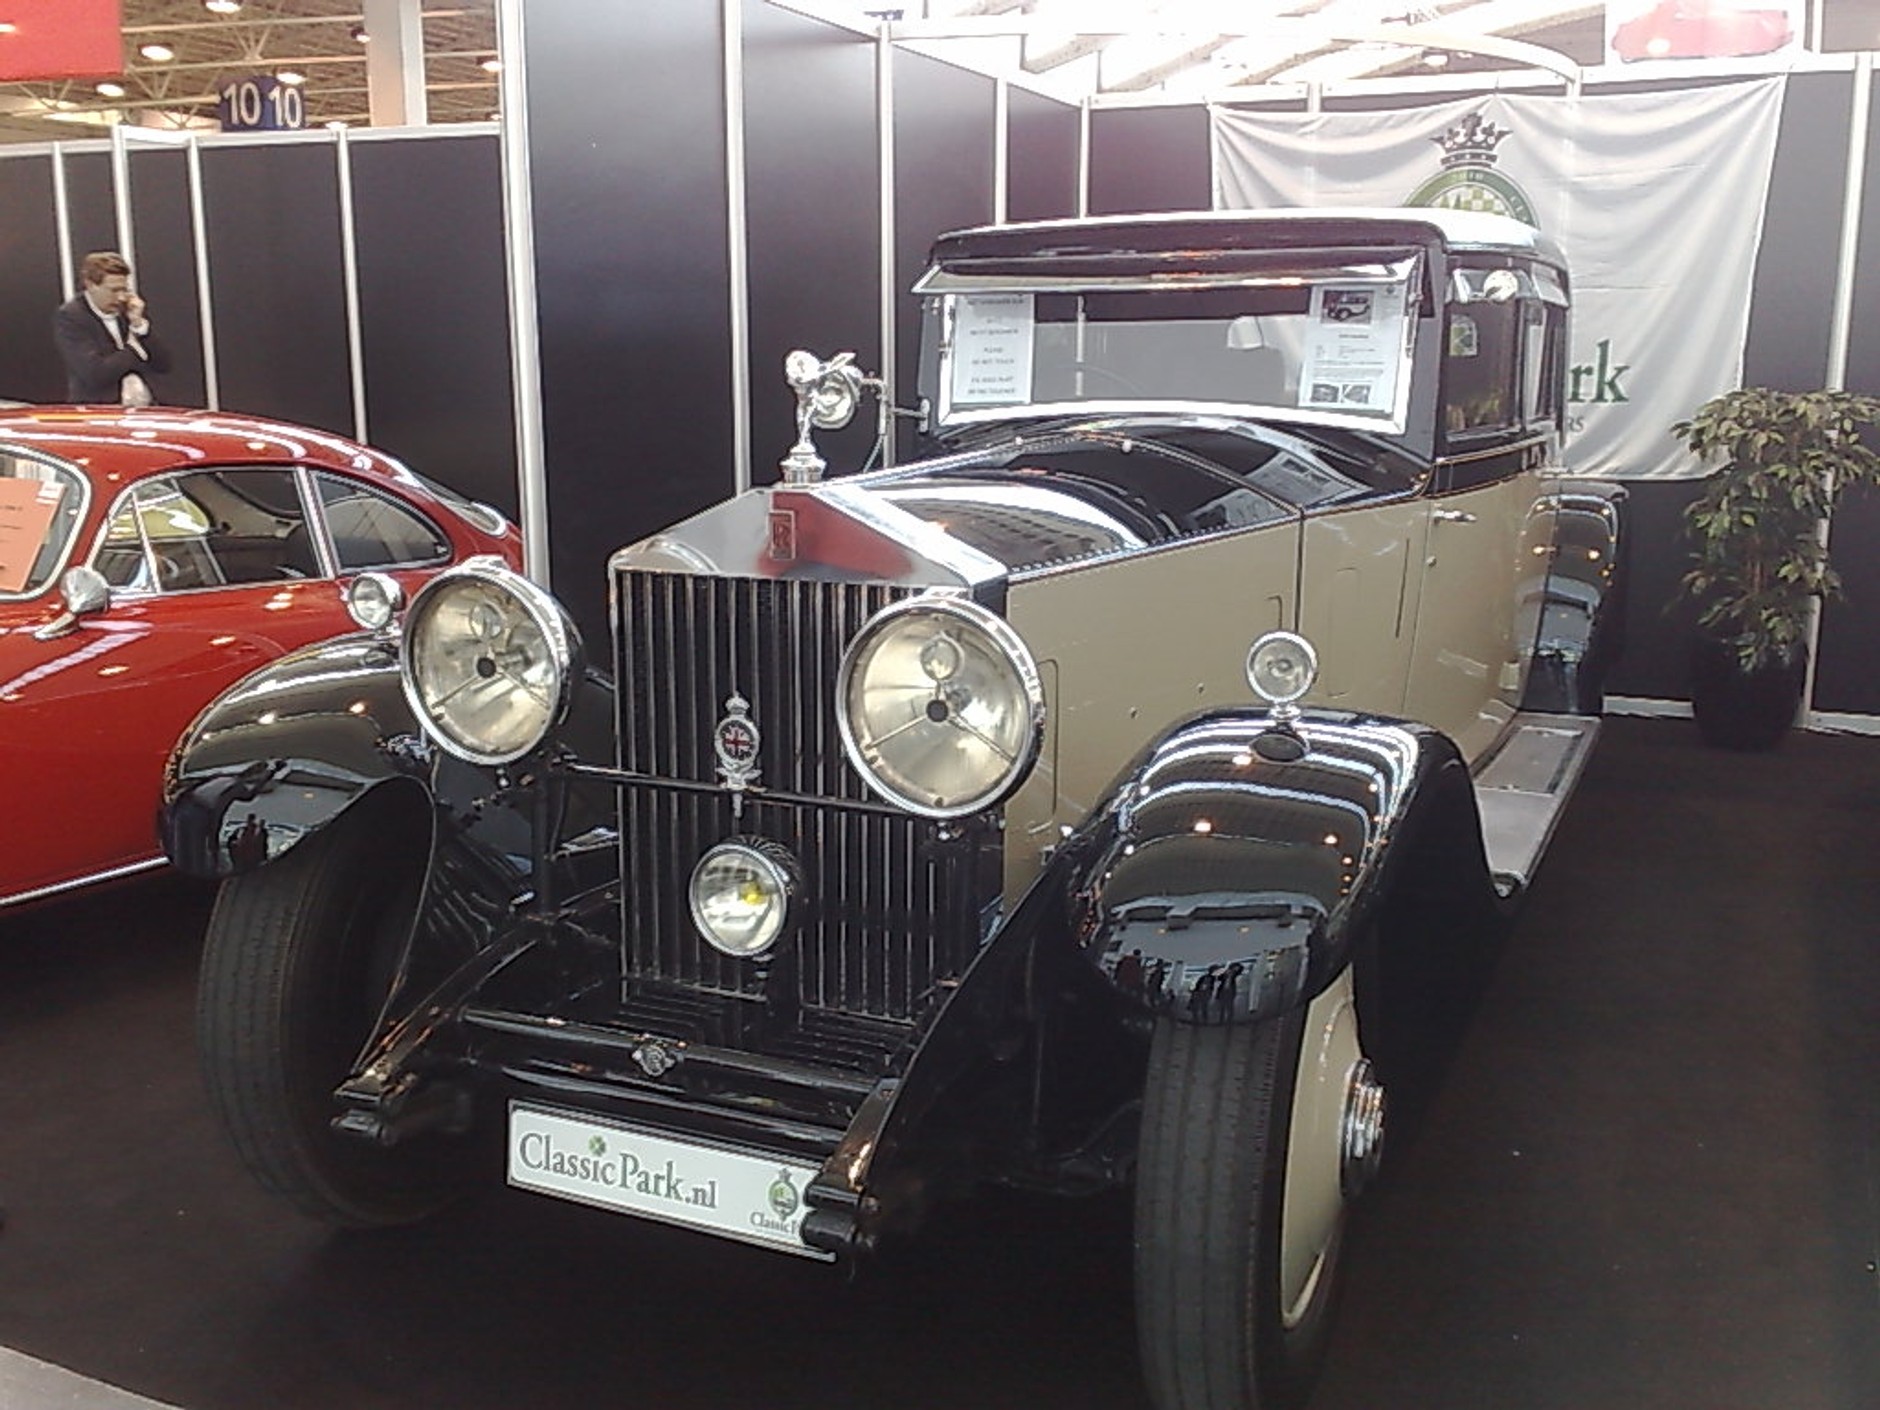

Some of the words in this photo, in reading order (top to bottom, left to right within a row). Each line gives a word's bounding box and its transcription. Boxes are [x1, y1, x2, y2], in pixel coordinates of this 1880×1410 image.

[223, 82, 261, 126] 10
[269, 85, 303, 128] 10
[1567, 338, 1631, 403] rk
[519, 1132, 717, 1209] ClassicPark.nl
